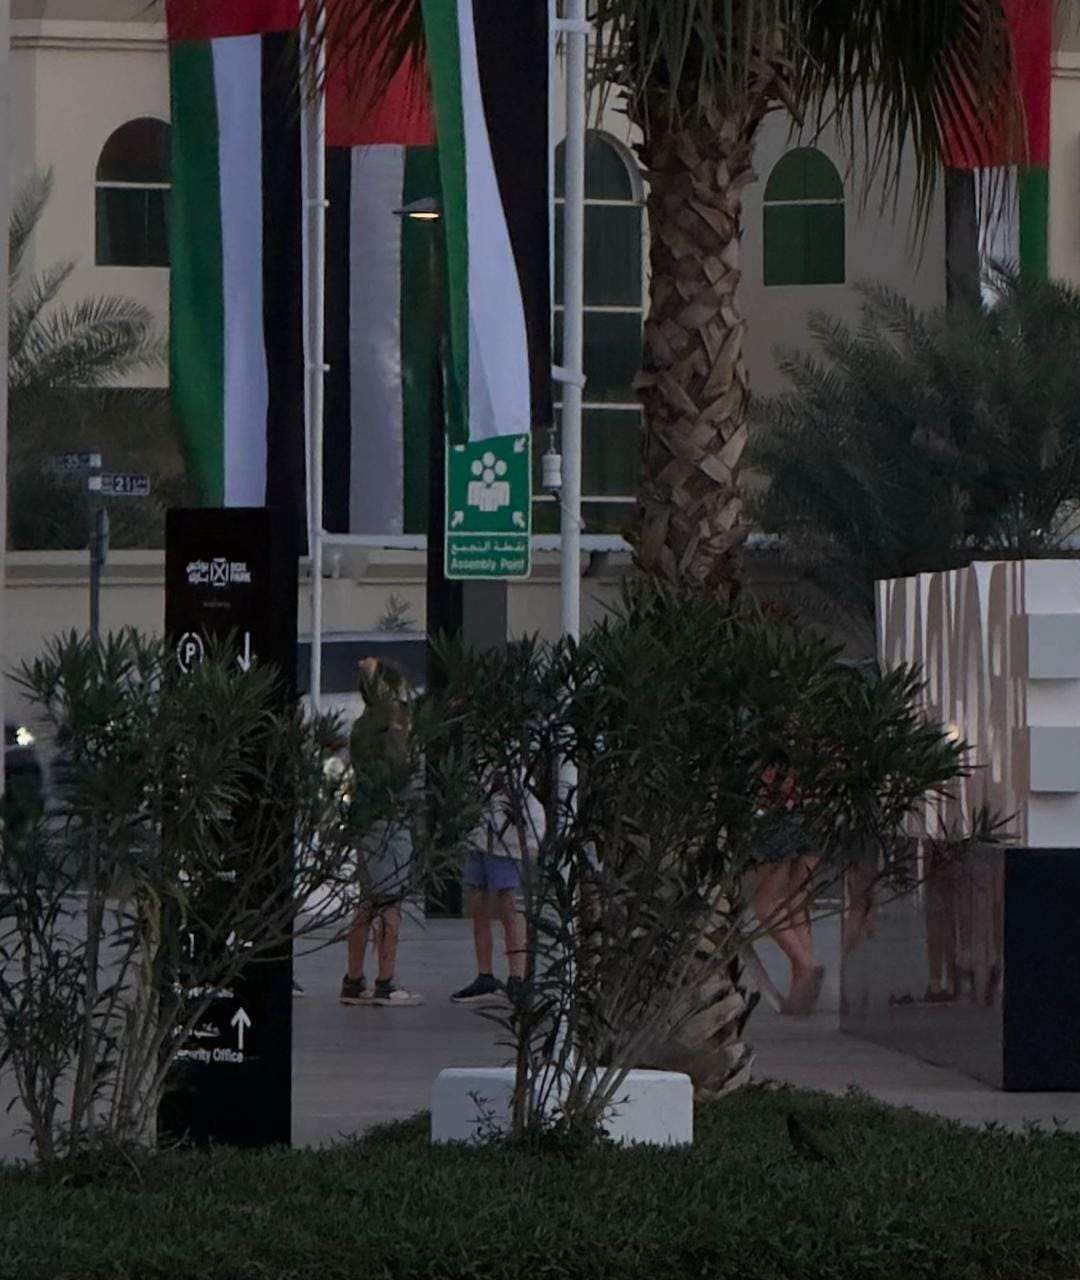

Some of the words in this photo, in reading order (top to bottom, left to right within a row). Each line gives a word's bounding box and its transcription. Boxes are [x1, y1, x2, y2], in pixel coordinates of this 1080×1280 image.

[493, 541, 526, 552] نقطة
[451, 558, 497, 572] Assembly
[500, 557, 525, 570] Point
[185, 642, 196, 664] P
[173, 1047, 212, 1064] ecurity
[212, 1047, 244, 1063] Office
